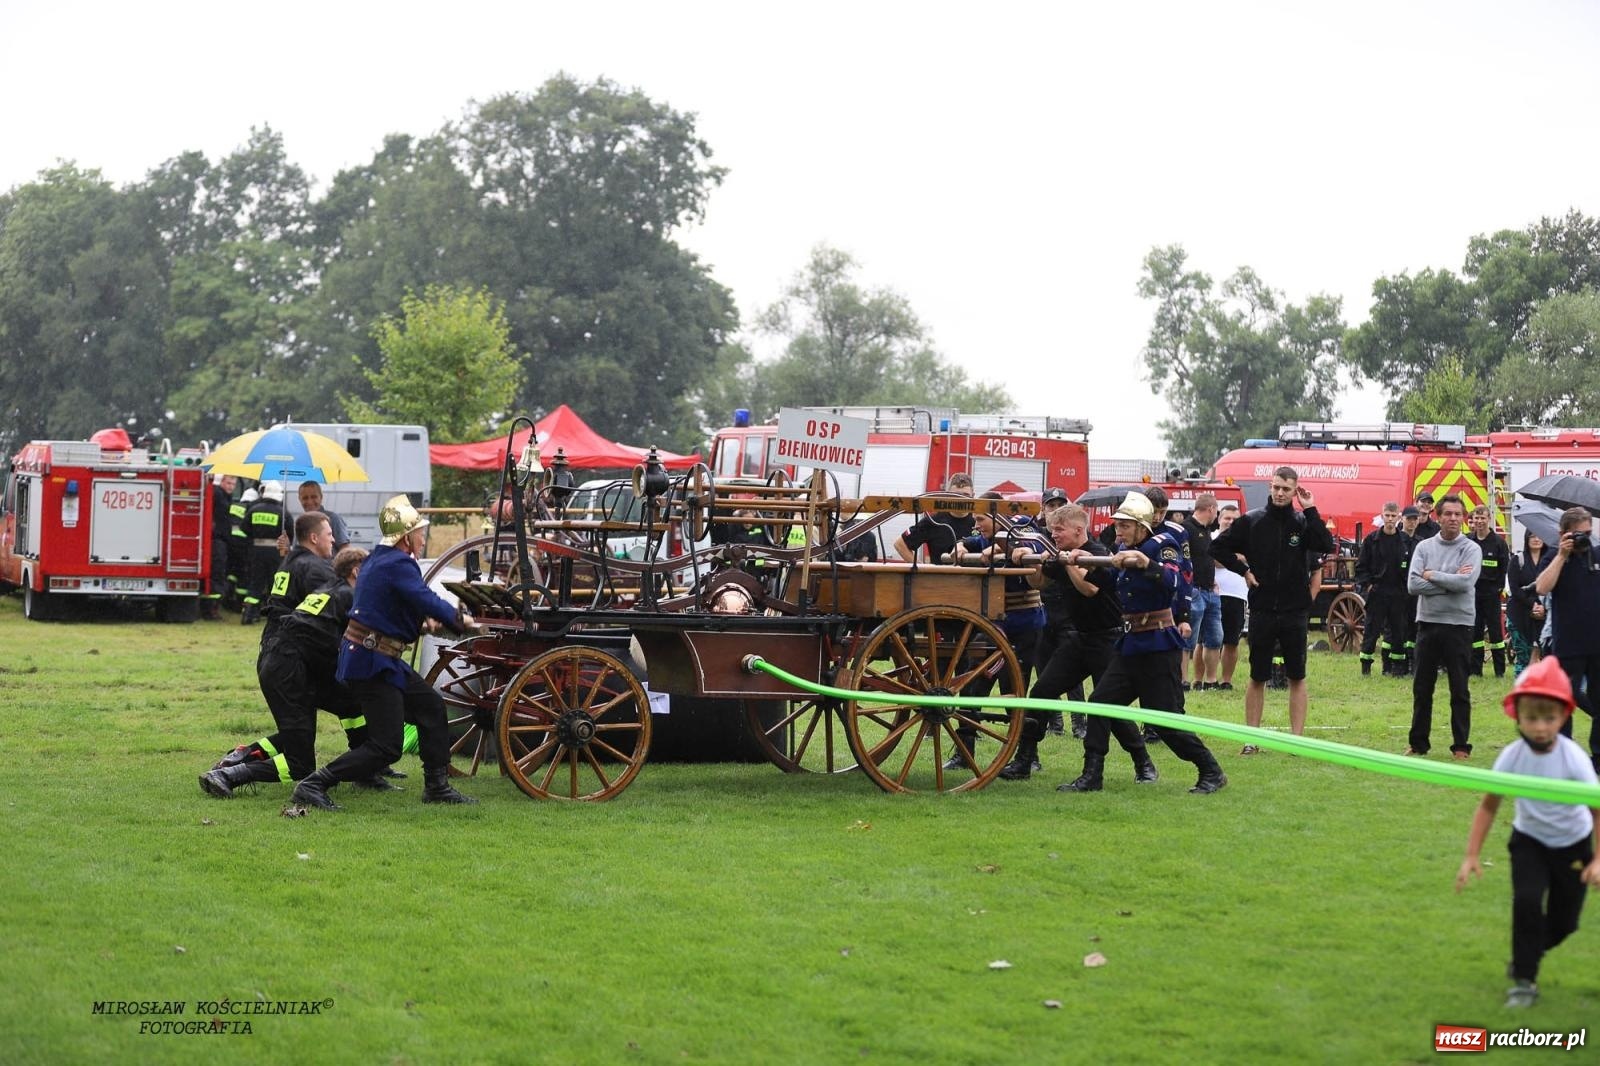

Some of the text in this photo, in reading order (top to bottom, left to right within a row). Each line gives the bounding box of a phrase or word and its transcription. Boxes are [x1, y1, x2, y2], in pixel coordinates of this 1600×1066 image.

[806, 419, 841, 440] OSP
[777, 438, 864, 467] BIENKOWICE
[985, 438, 1010, 457] 428
[1019, 440, 1036, 458] 43
[1059, 467, 1076, 477] 1/23
[102, 490, 127, 510] 428
[136, 491, 153, 510] 29
